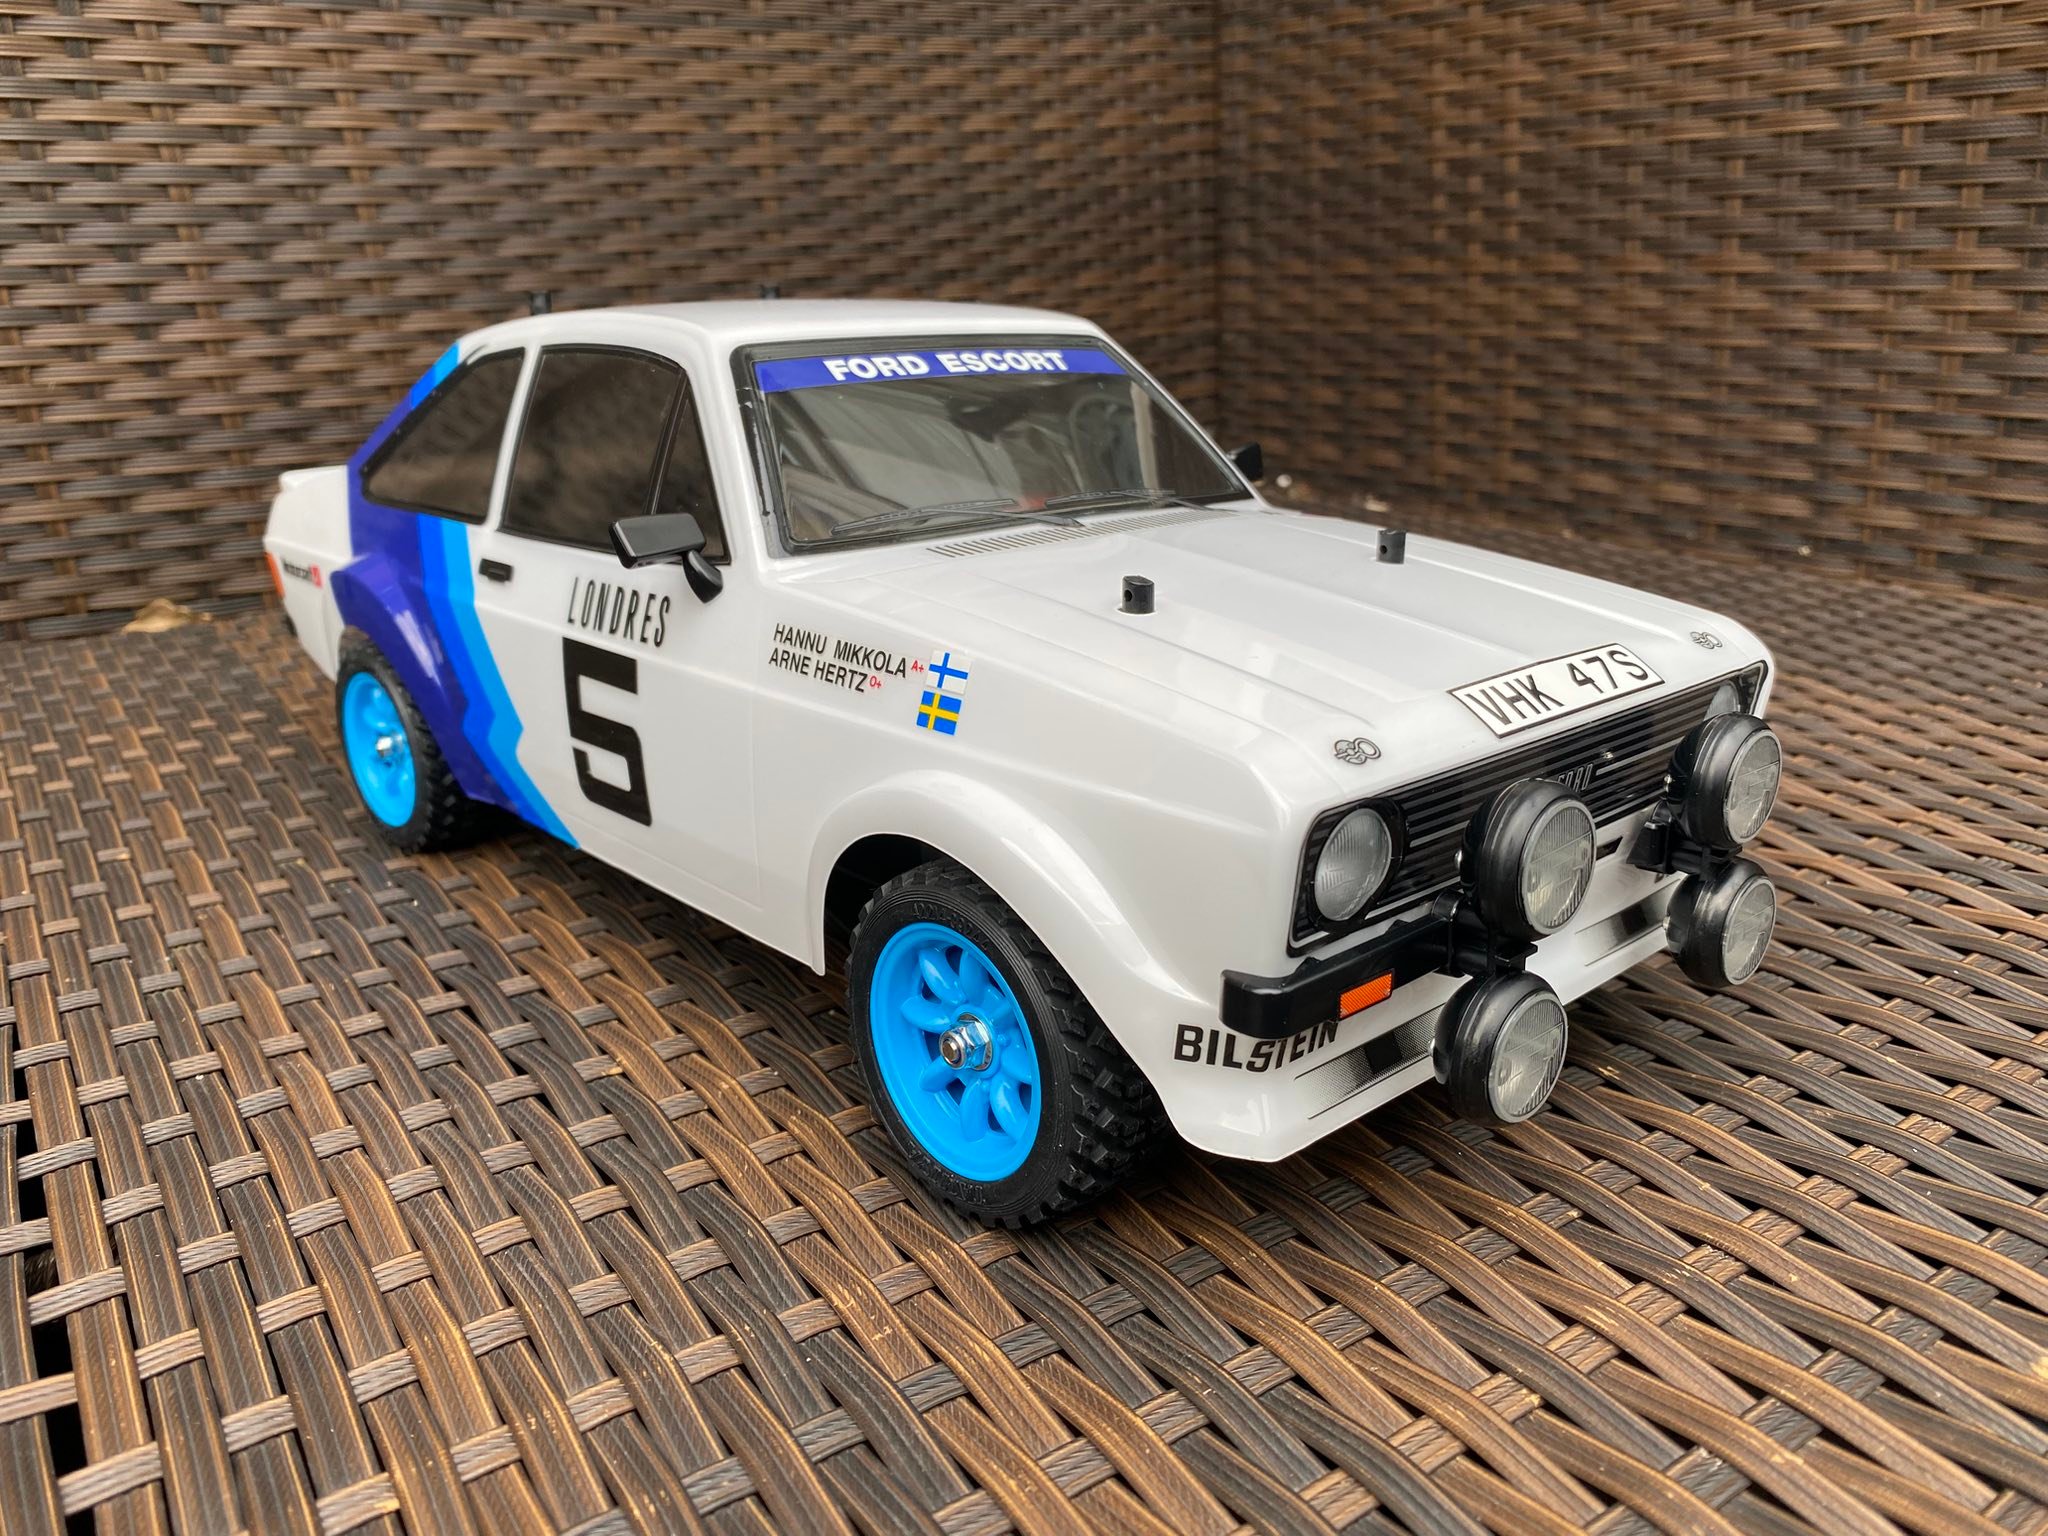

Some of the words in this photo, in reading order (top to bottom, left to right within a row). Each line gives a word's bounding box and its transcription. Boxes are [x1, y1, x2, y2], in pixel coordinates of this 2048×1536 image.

[823, 354, 930, 381] FORD
[934, 350, 1069, 373] ESCORT
[567, 577, 671, 648] LONDRES
[769, 648, 812, 676] ARNE
[813, 660, 868, 693] HERTZ
[773, 623, 827, 654] HANNU
[833, 640, 907, 678] MIKKOLA
[1465, 673, 1565, 726] VHK
[1565, 650, 1649, 694] 47S
[562, 636, 653, 828] 5
[1174, 1022, 1339, 1073] BILSTEIN
